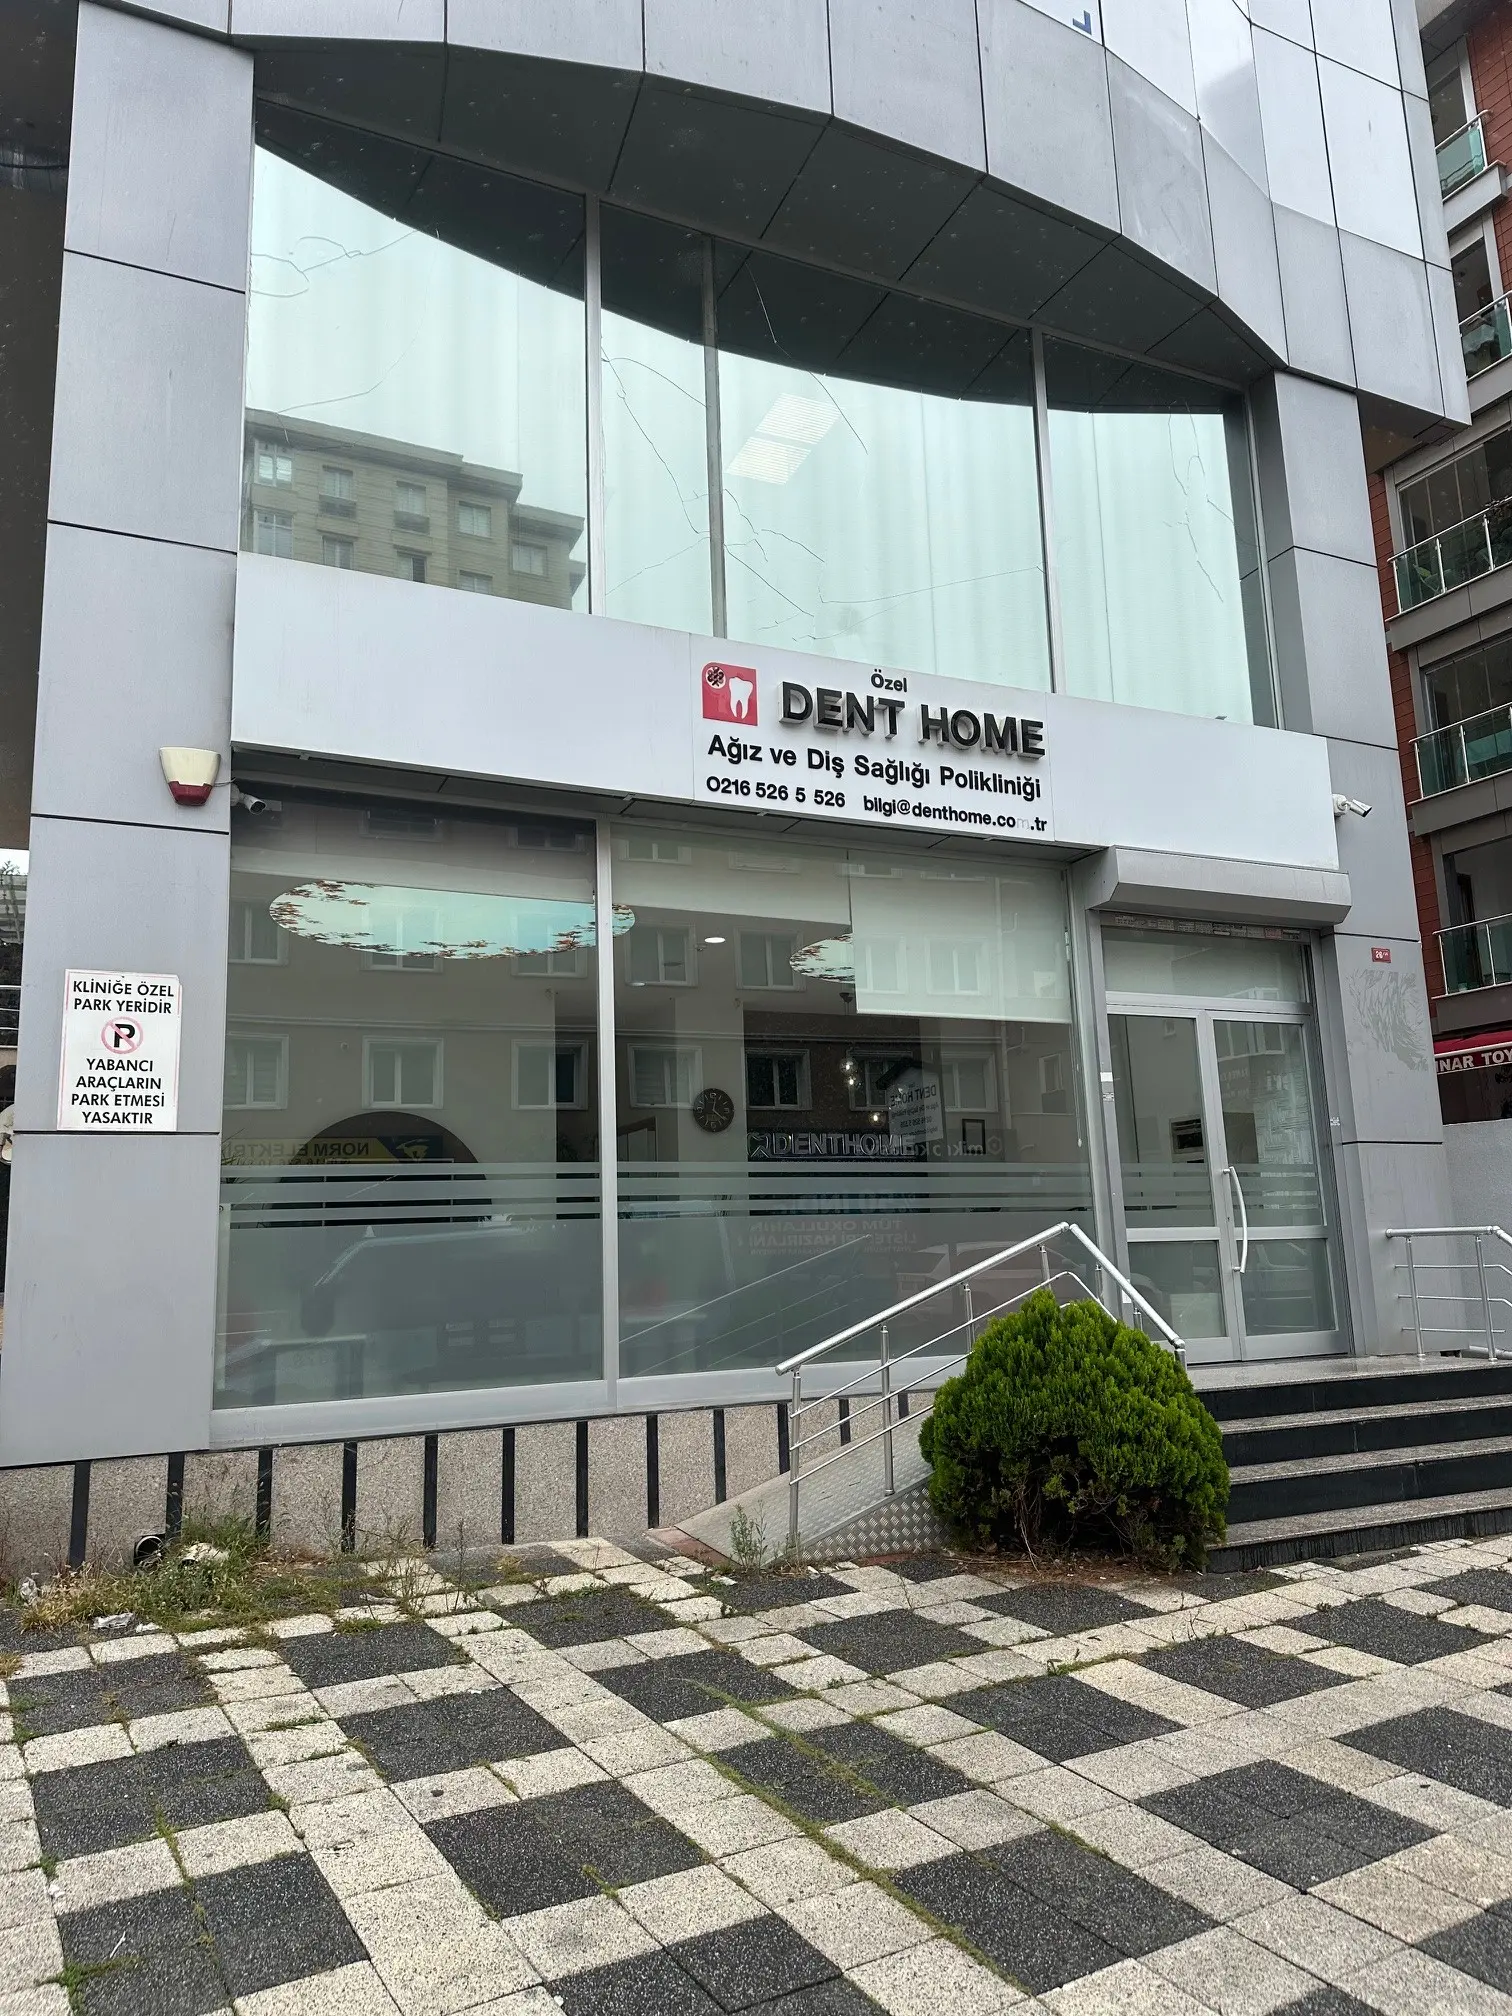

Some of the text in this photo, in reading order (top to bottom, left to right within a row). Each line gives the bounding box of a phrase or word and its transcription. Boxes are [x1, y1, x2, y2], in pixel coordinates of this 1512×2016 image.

[870, 668, 908, 692] Özel
[778, 681, 1046, 759] DENT HOME
[707, 734, 1041, 802] Ağız ve Diş Sağlığı Polikliniği
[755, 781, 789, 801] 526
[795, 786, 806, 803] 5
[813, 788, 846, 808] 526
[73, 978, 175, 997] KLİNİĞE ÖZEL
[74, 998, 172, 1014] PARK YERİDİR
[86, 1058, 153, 1072] YABANCI
[76, 1076, 162, 1092] ARAÇLARIN
[71, 1092, 165, 1107] PARK ETMESİ
[82, 1111, 153, 1124] YASAKTIR
[773, 1131, 917, 1158] DENTHOME
